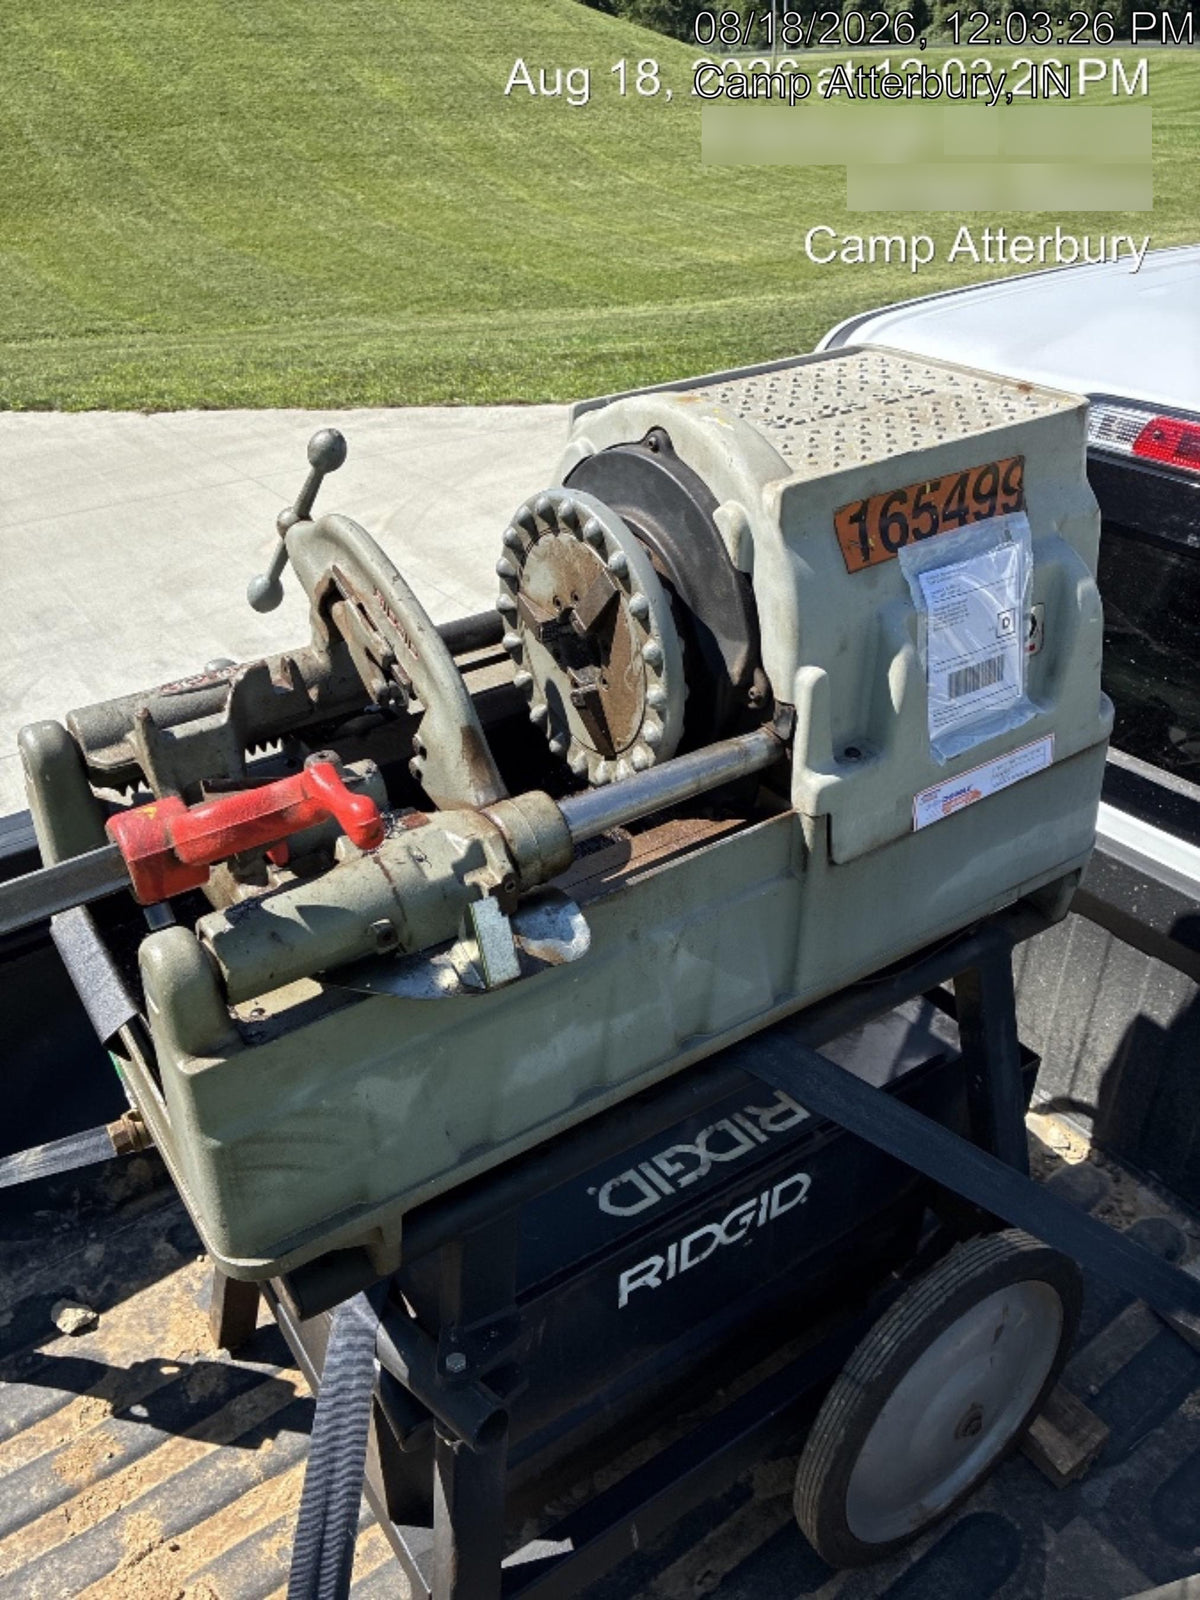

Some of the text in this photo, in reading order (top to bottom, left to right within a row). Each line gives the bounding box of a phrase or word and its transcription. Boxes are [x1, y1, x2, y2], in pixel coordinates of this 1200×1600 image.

[848, 457, 1024, 562] 165499
[598, 1090, 811, 1218] RIDGID
[618, 1172, 812, 1309] RIDGID
